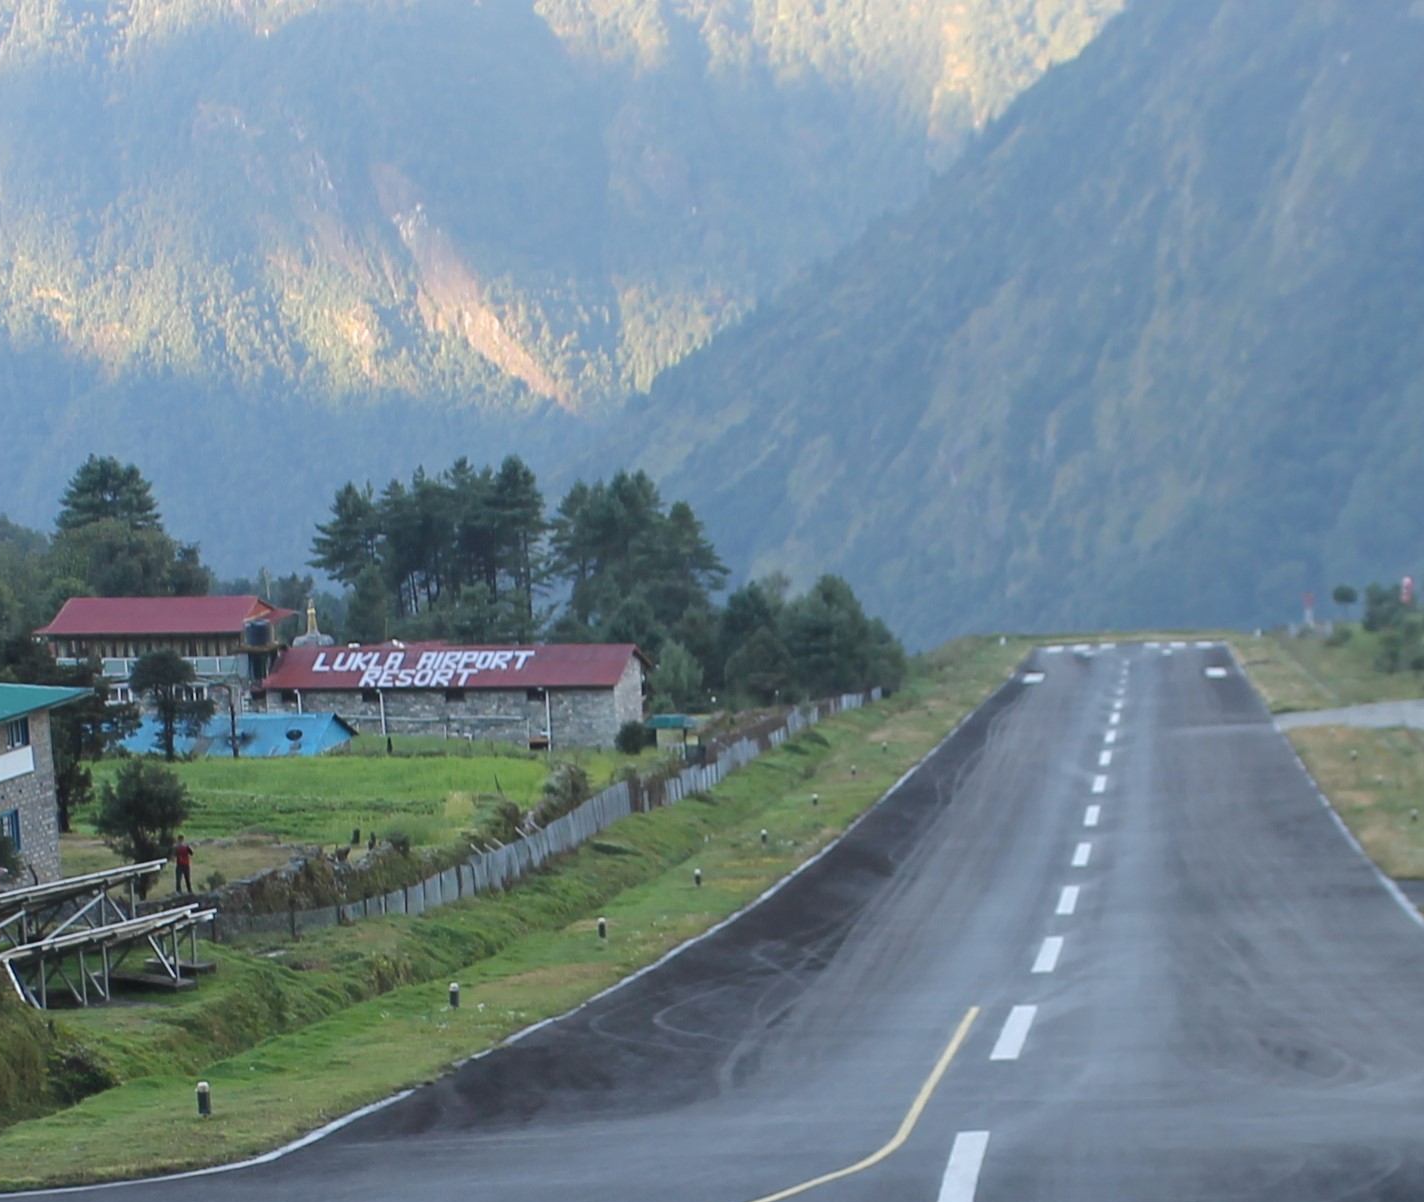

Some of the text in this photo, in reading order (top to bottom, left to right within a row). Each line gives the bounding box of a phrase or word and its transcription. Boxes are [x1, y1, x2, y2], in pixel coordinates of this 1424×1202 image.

[312, 650, 535, 672] LUKLA AIRPORT
[358, 668, 479, 688] RESORT
